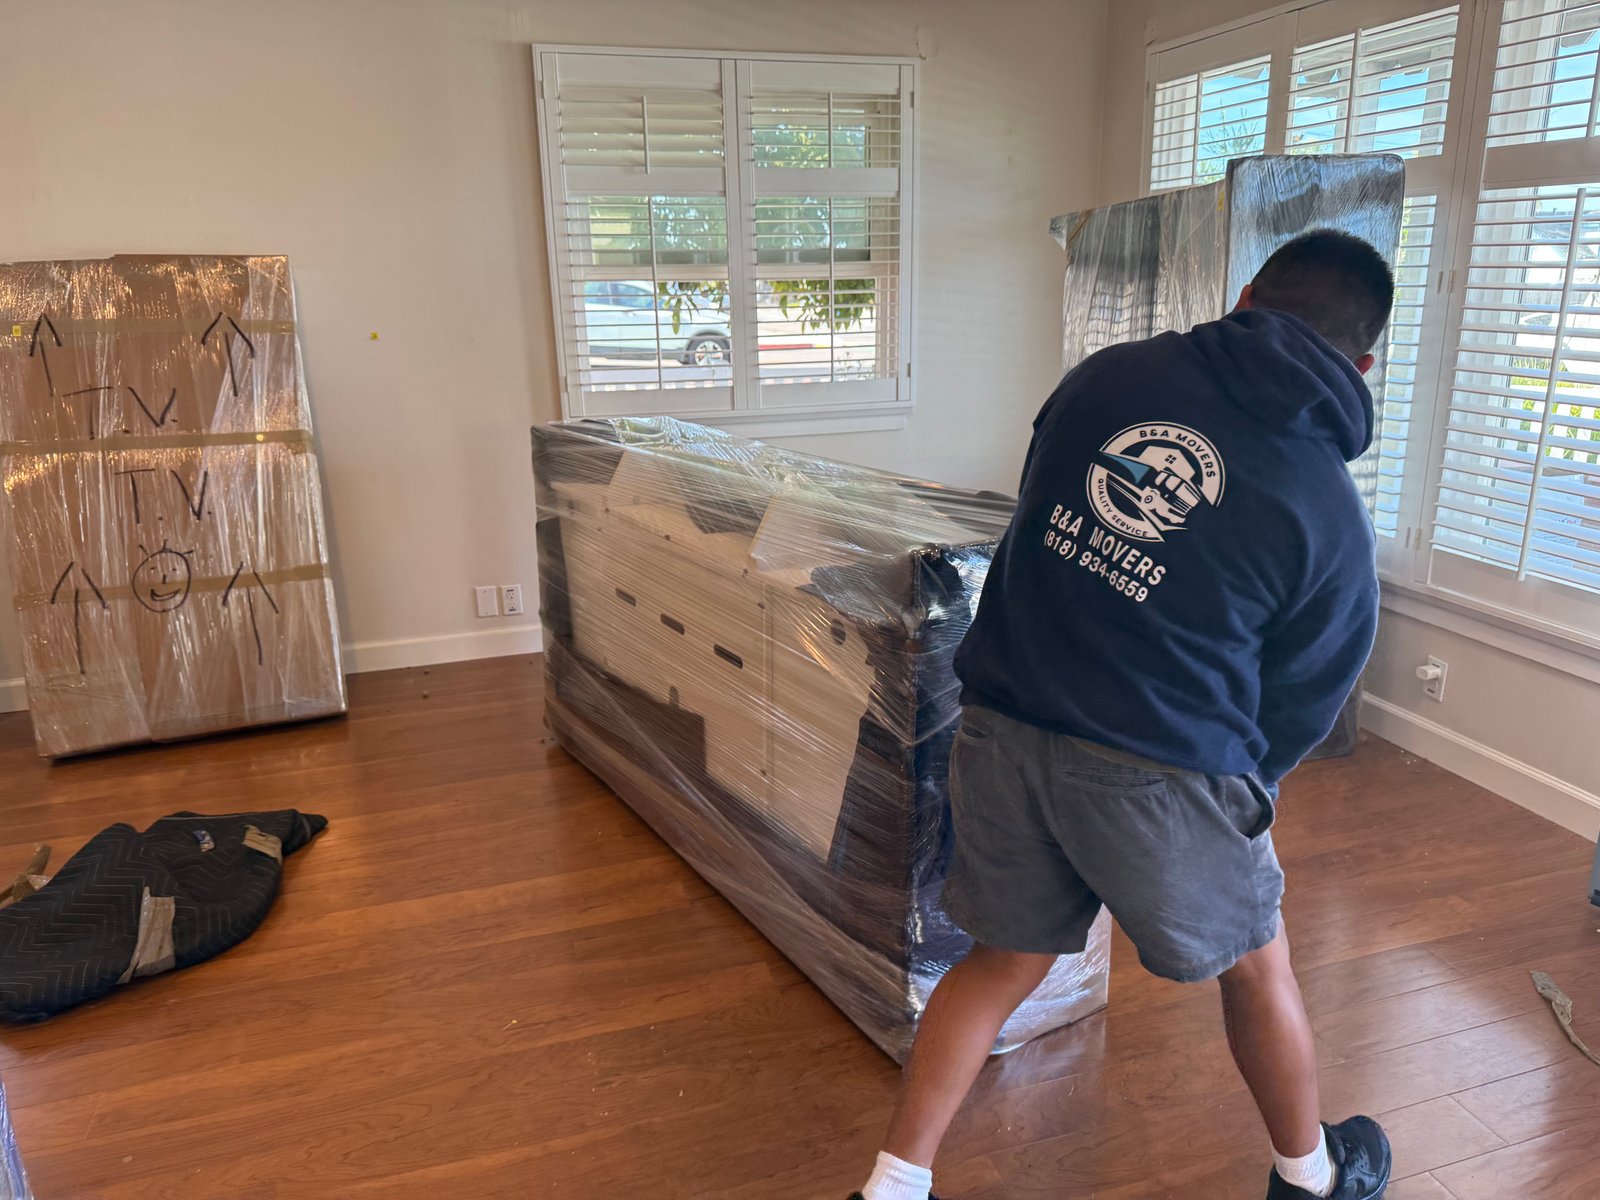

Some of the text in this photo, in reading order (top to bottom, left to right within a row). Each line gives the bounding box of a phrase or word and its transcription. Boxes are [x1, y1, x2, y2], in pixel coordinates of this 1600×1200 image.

[62, 385, 178, 440] T.V.
[1139, 429, 1216, 478] B&A MOVERS
[114, 468, 212, 524] T.V.
[1098, 478, 1149, 537] QUALITY SERVICE
[1044, 529, 1148, 602] (818) 934-6559
[1050, 504, 1166, 586] B&A MOVERS
